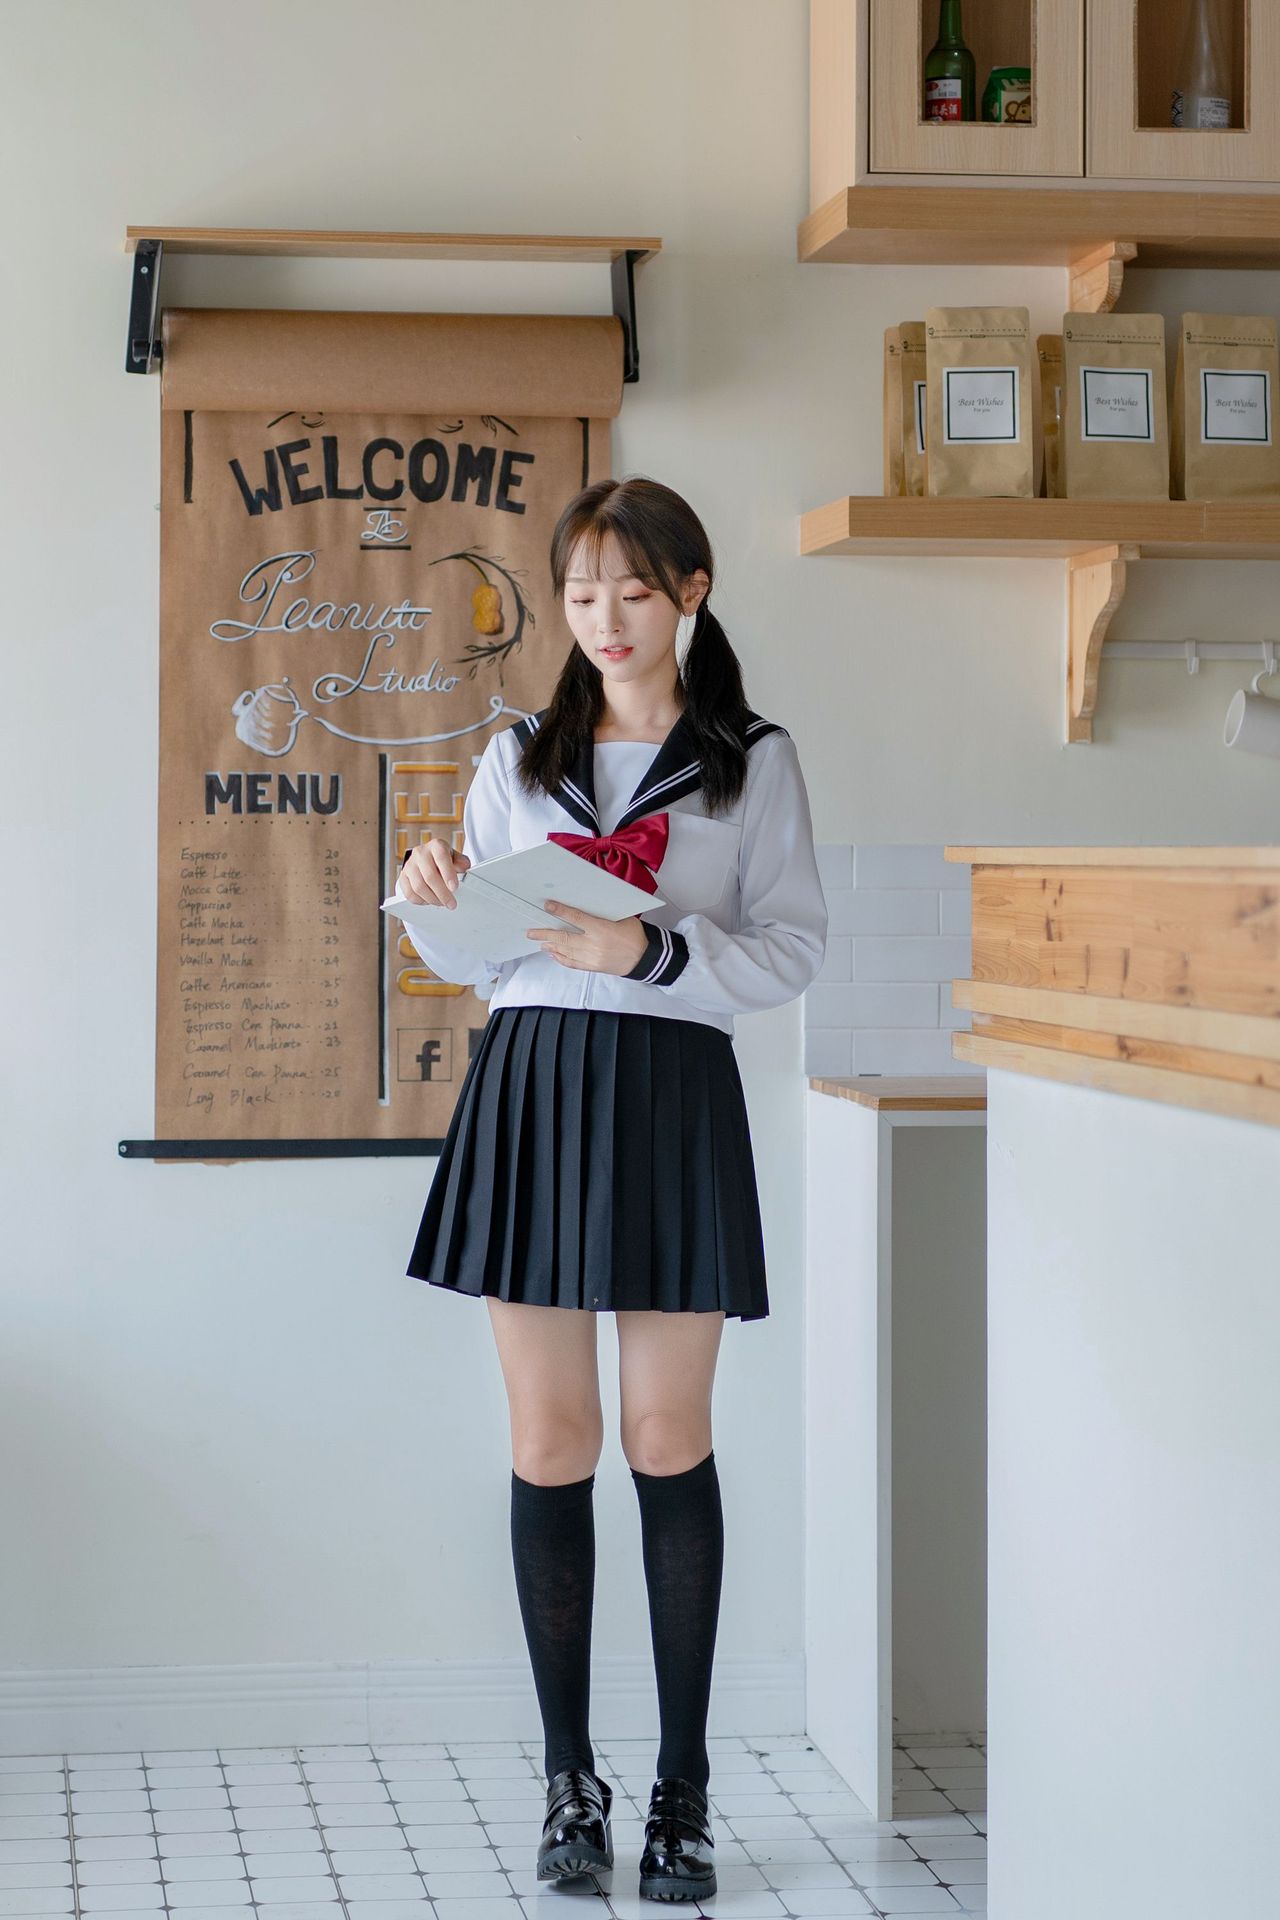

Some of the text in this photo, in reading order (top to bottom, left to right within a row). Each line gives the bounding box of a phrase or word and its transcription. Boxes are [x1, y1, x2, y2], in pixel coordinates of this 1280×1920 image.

[958, 396, 1005, 407] Best Wishes
[228, 435, 535, 516] WELCOME
[312, 632, 461, 703] Studio
[204, 771, 342, 815] MENU
[180, 848, 339, 865] Espresso 20
[180, 865, 340, 879] Caffe Latte 23
[216, 882, 241, 895] Caffe
[323, 883, 339, 894] 23
[323, 897, 341, 908] 24
[180, 916, 338, 929] Caffe Mocha 21
[231, 933, 258, 945] Latte
[324, 935, 339, 944] 23
[220, 953, 254, 967] Mocha
[324, 955, 339, 967] 24
[180, 977, 211, 992] Caffe
[324, 978, 341, 988] 25
[183, 998, 231, 1016] Espresso
[325, 999, 339, 1008] 23
[183, 1018, 232, 1040] Espresso
[324, 1021, 338, 1031] 21
[325, 1036, 341, 1048] 23
[416, 1040, 441, 1081] f
[324, 1066, 341, 1078] 25
[186, 1087, 214, 1113] Long
[230, 1085, 276, 1107] Black
